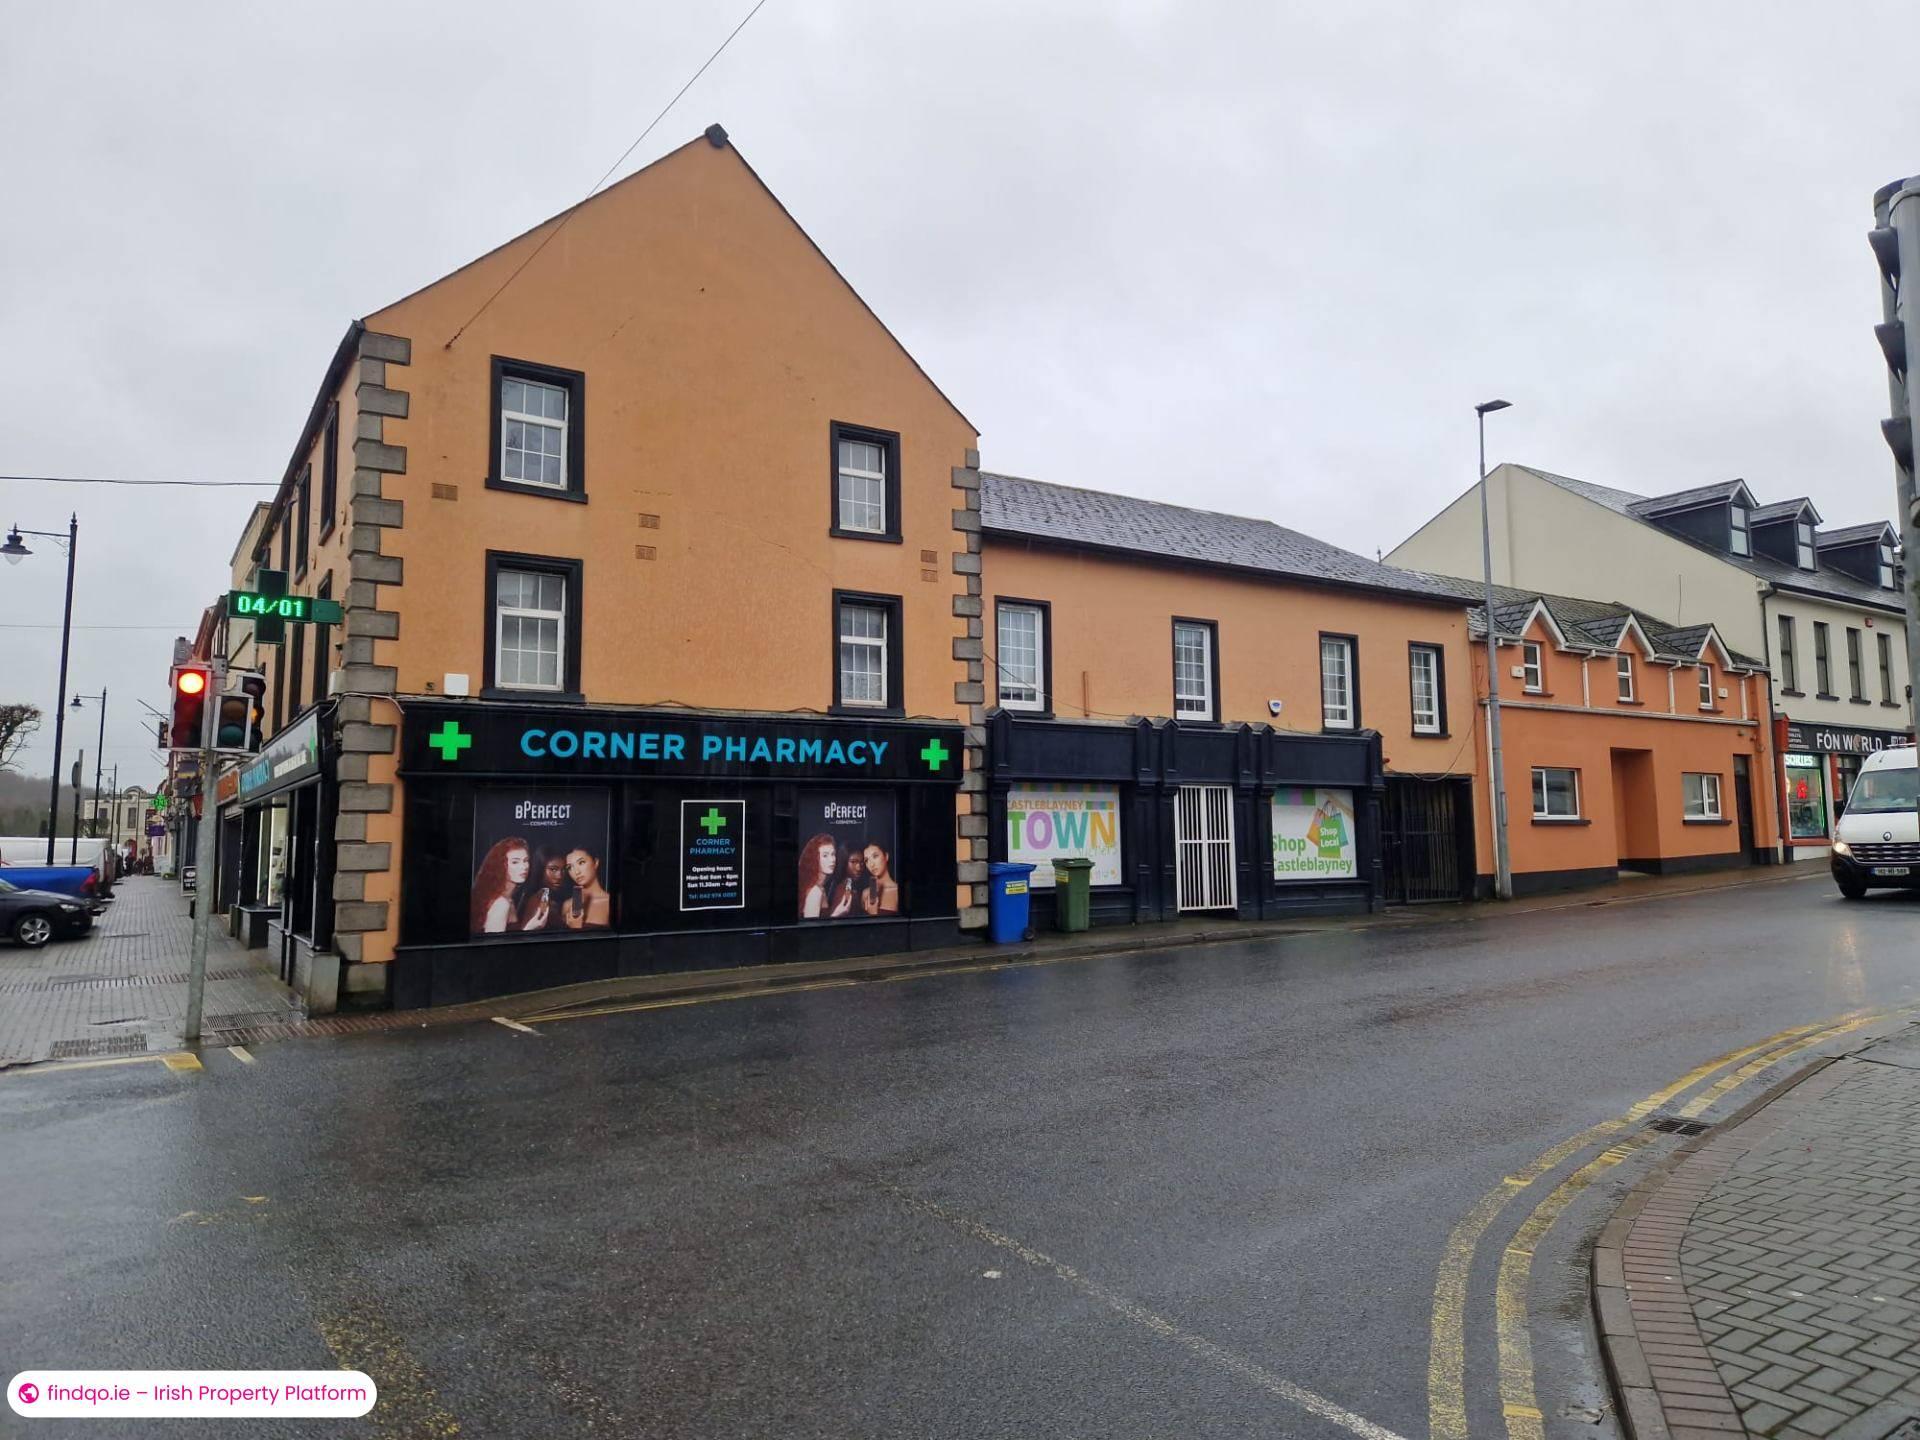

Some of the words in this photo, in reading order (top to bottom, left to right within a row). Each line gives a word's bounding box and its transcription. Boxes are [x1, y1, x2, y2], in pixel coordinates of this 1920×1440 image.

[238, 595, 302, 617] 04/01
[520, 729, 685, 760] CORNER
[702, 735, 889, 765] PHARMACY
[515, 800, 571, 819] BPERFECT
[824, 802, 866, 818] BPERFECT
[1008, 811, 1115, 850] TOWN
[1320, 827, 1338, 836] Shop
[1320, 838, 1339, 847] Local
